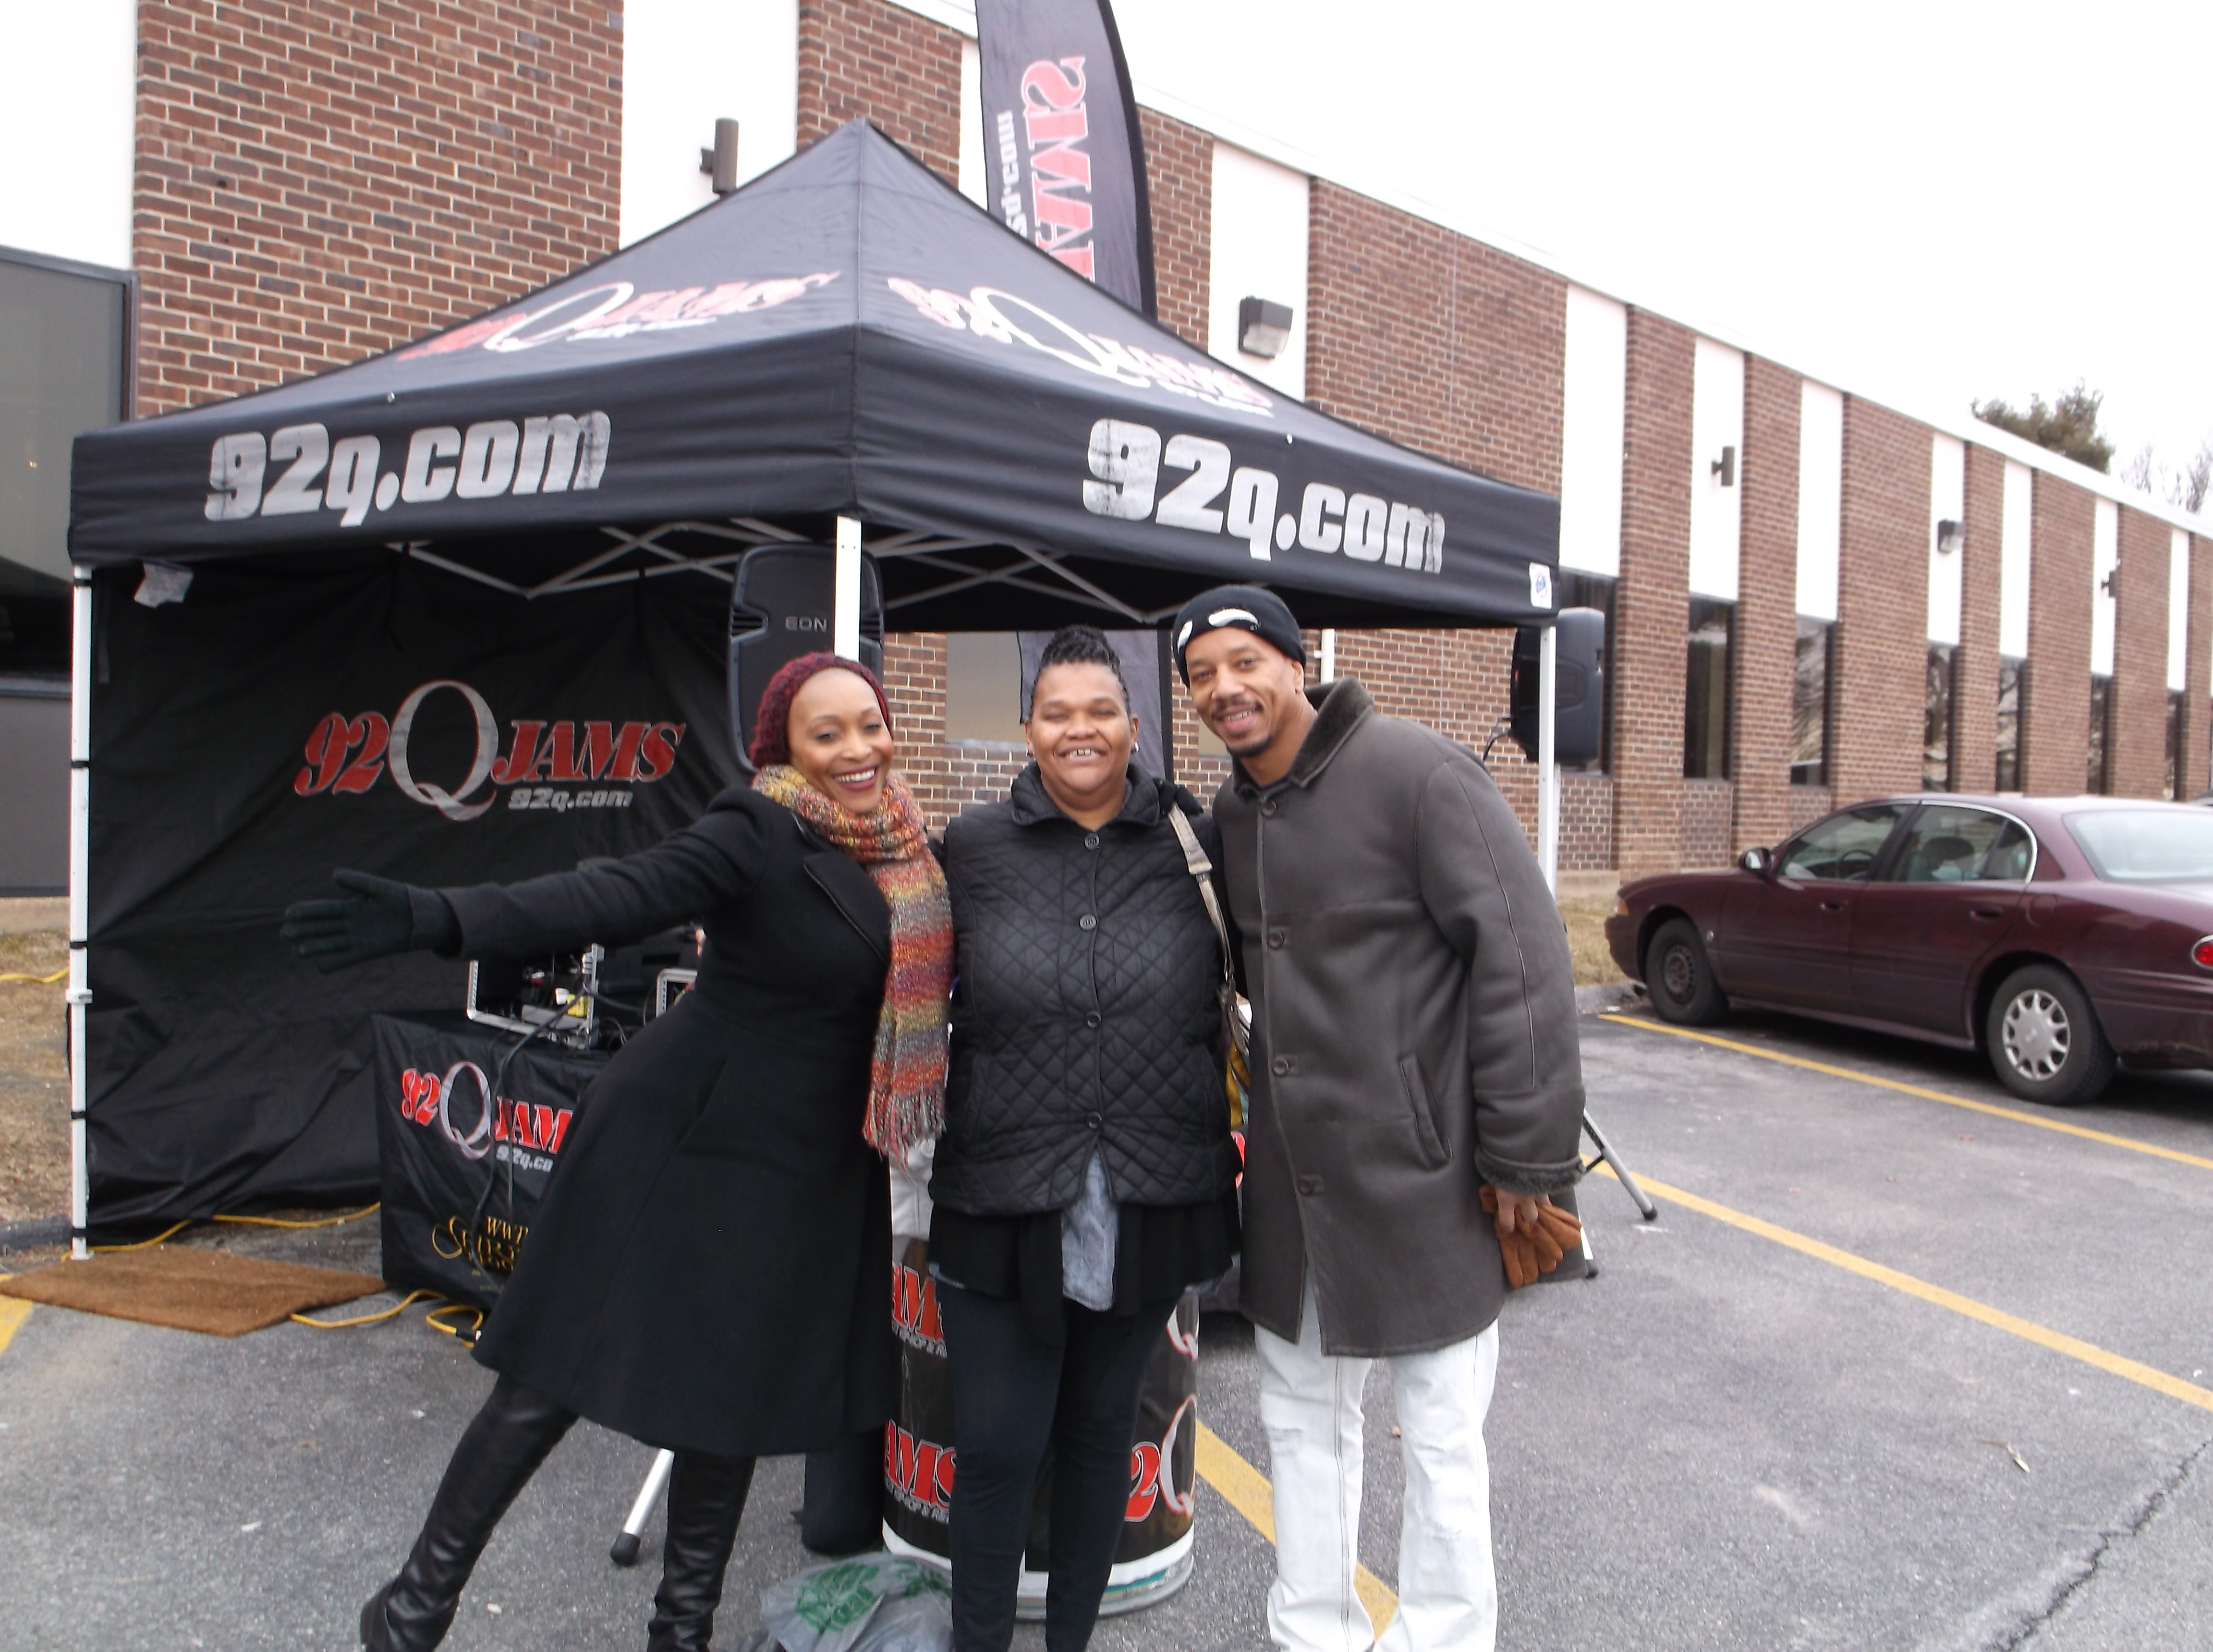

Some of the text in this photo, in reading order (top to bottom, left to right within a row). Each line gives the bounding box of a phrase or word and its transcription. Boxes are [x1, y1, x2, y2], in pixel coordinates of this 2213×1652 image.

[204, 411, 611, 527] 92q.com
[1082, 418, 1445, 574] 92q.com
[785, 616, 827, 632] EON
[491, 720, 686, 785] JAMS
[508, 788, 633, 813] 92q.com
[494, 1095, 573, 1154] JAM
[496, 1144, 554, 1173] 92q.co
[885, 1419, 957, 1510] AMS
